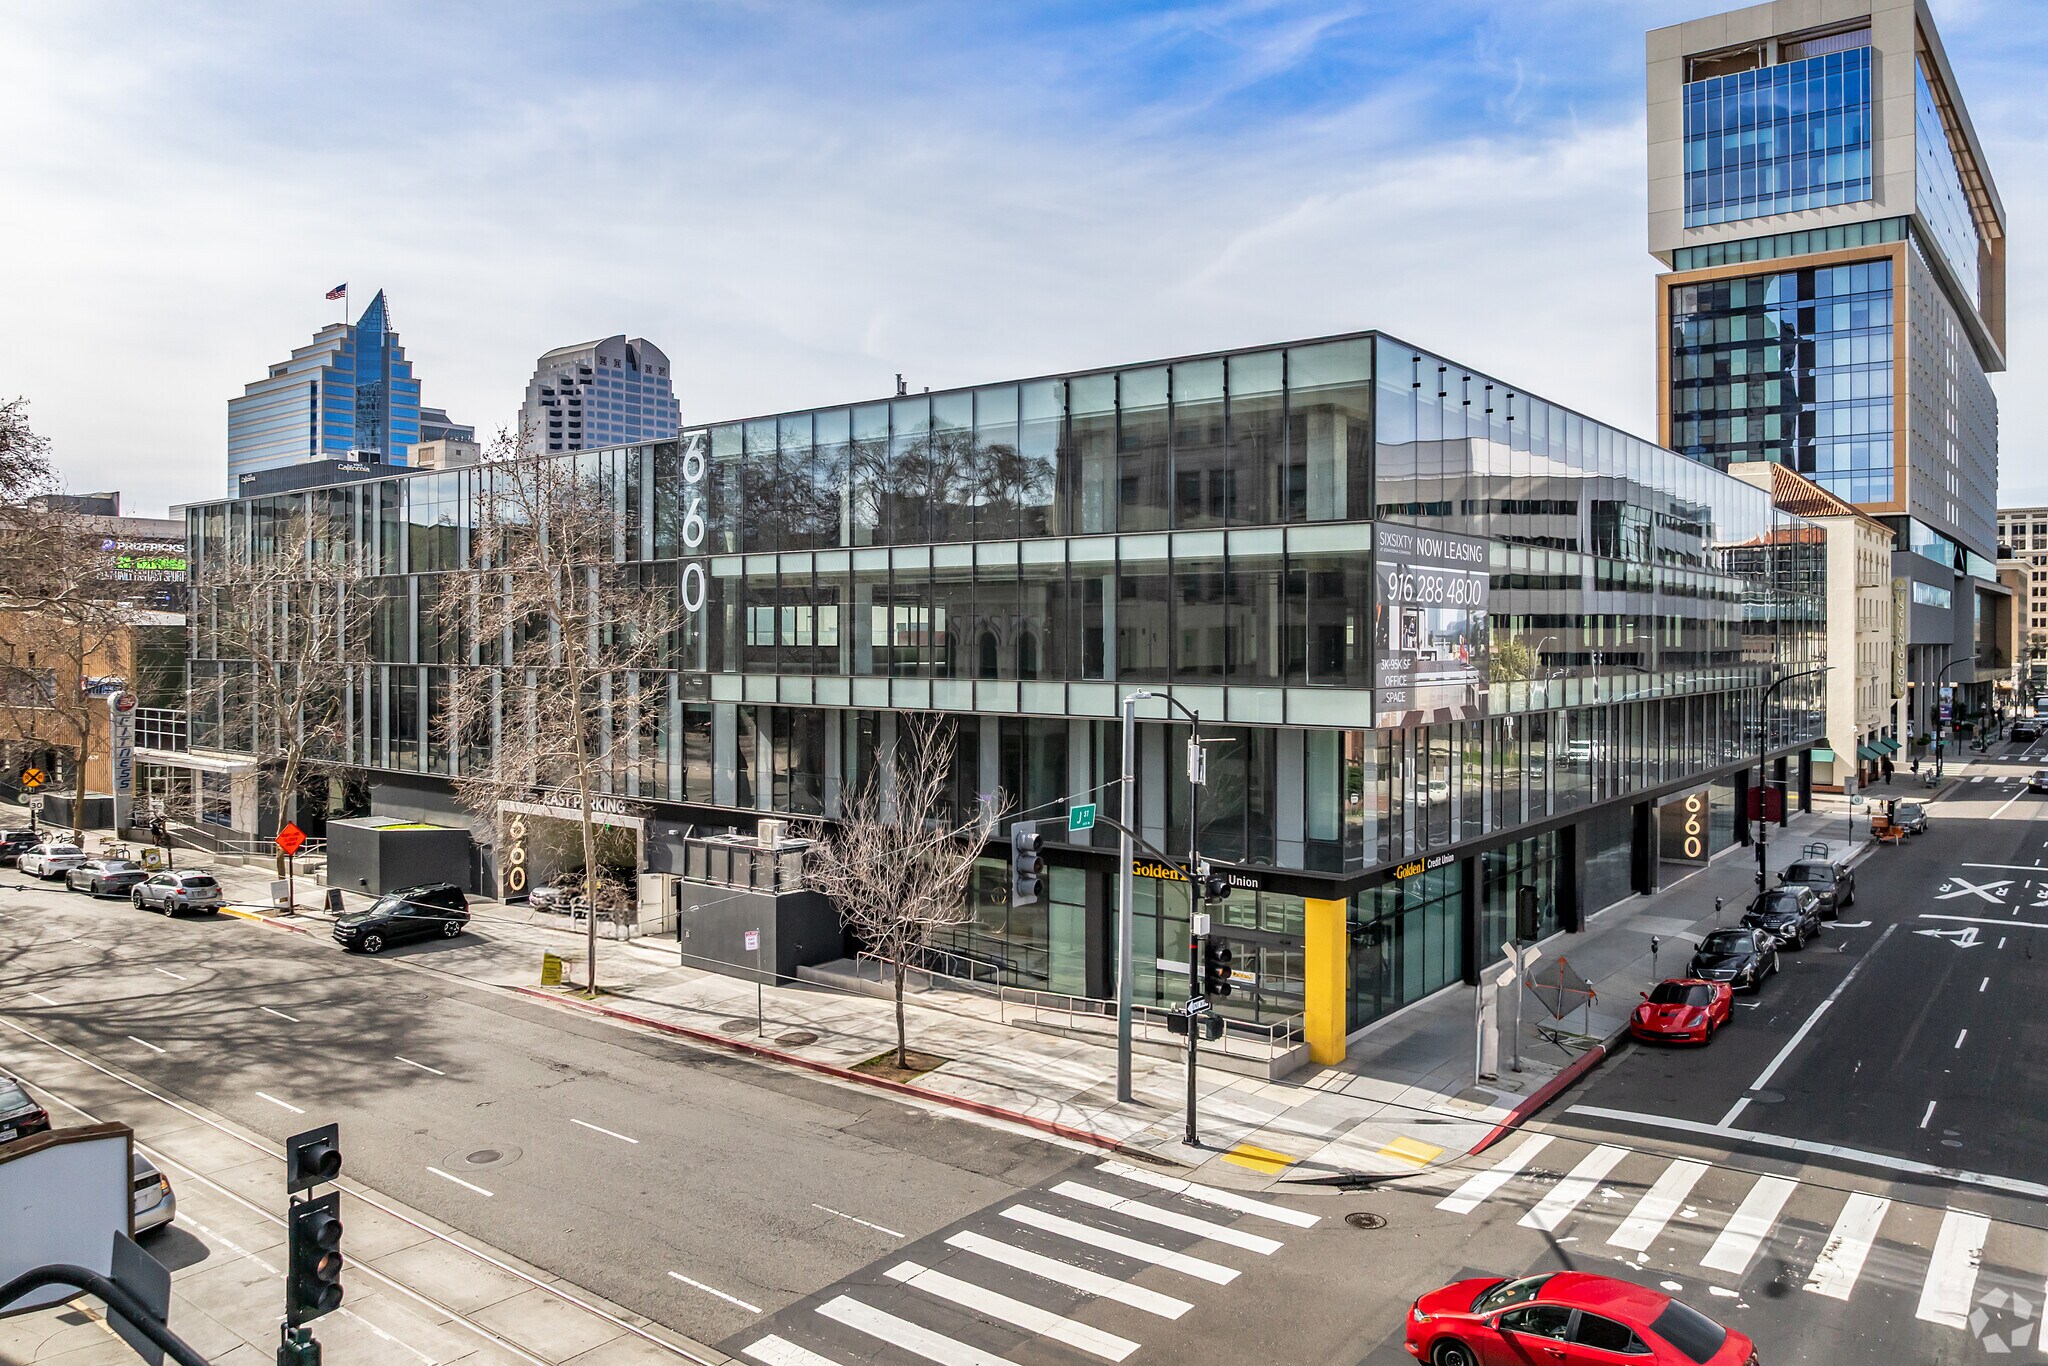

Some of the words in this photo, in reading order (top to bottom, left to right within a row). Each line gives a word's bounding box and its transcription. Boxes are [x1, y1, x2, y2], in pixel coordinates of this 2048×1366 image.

[682, 434, 706, 613] 660
[1380, 531, 1413, 549] SIXSIXTY
[1417, 537, 1443, 558] NOW
[1444, 540, 1483, 563] LEASING
[1387, 572, 1413, 602] 916
[1416, 575, 1443, 604] 288
[1446, 578, 1482, 606] 4800
[1380, 659, 1403, 670] 3K-95K
[1403, 659, 1411, 670] SF
[1384, 675, 1408, 687] OFFICE
[1385, 691, 1406, 703] SPACE
[119, 716, 131, 789] FITNESS
[544, 791, 571, 808] EAST
[573, 794, 626, 814] PRKING
[1076, 811, 1082, 825] J
[1083, 810, 1090, 818] ST
[1684, 793, 1702, 858] 660
[509, 814, 526, 891] 660
[1427, 856, 1441, 869] Credit
[1441, 854, 1455, 865] Union
[1228, 874, 1259, 889] Union
